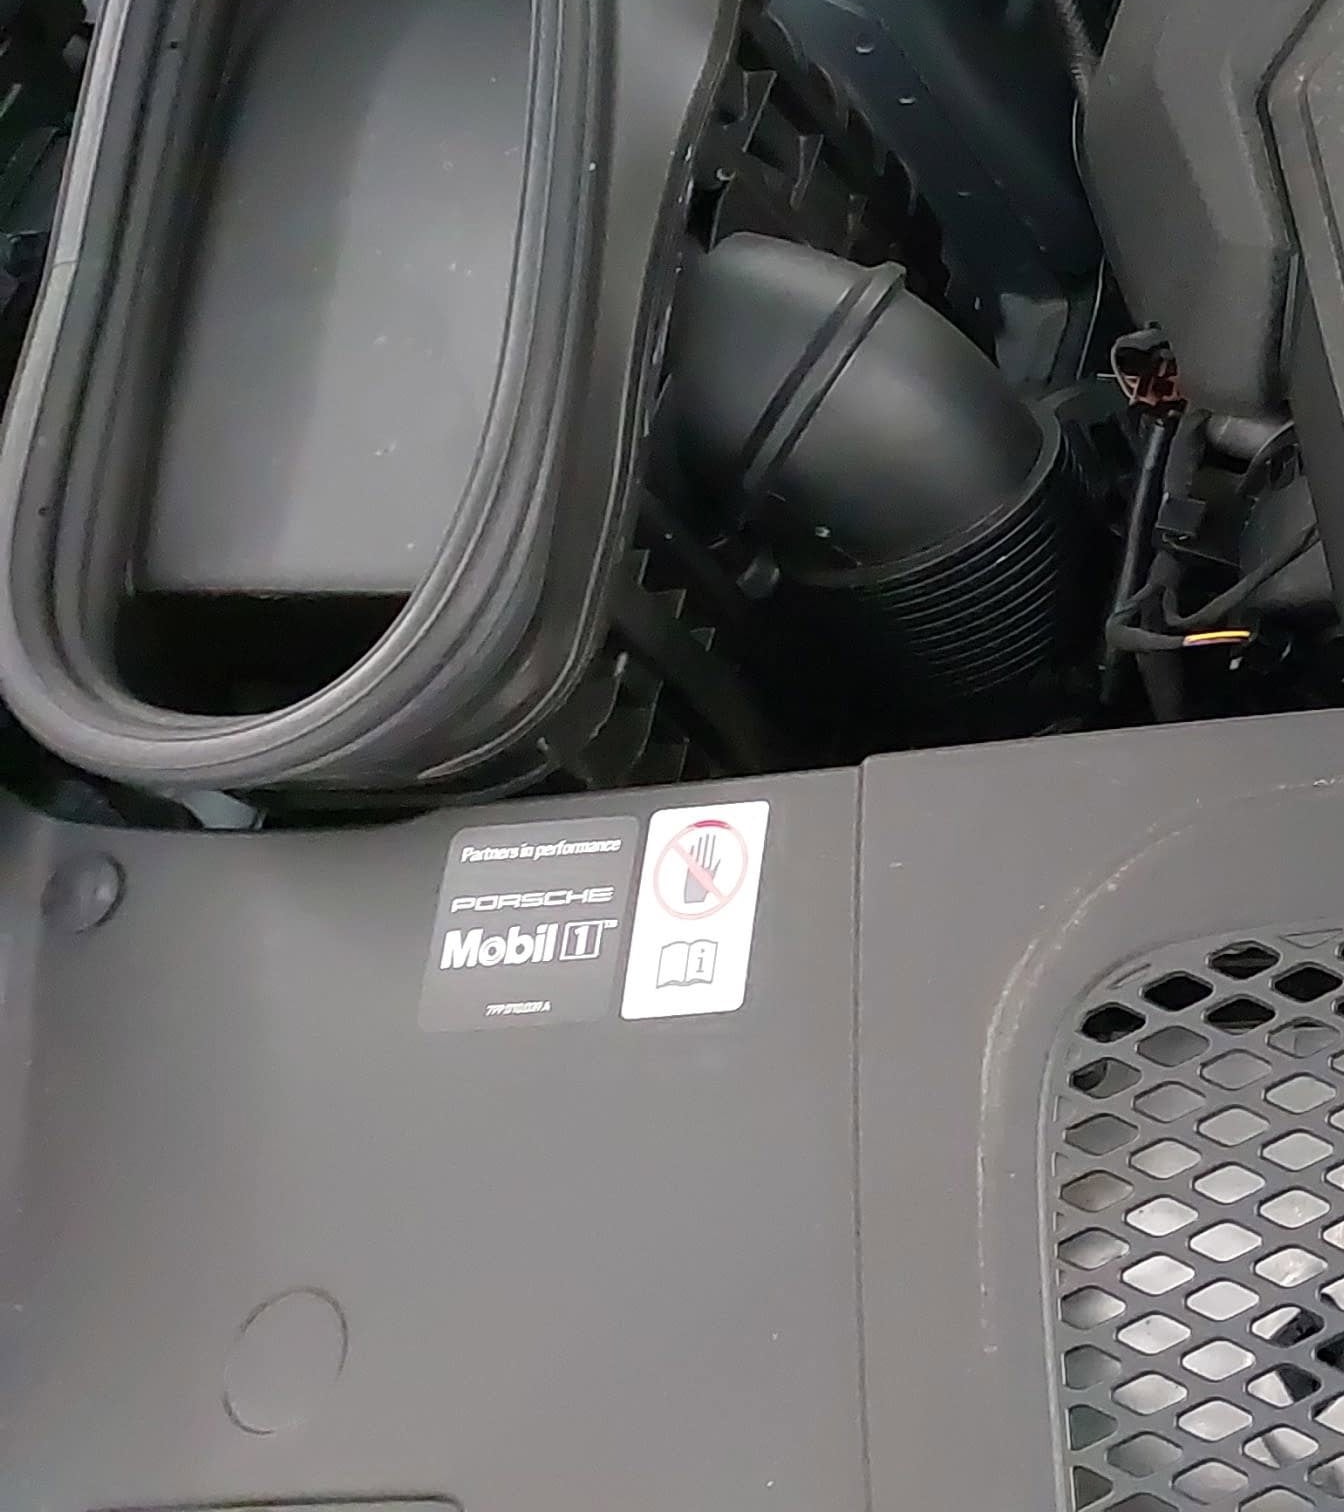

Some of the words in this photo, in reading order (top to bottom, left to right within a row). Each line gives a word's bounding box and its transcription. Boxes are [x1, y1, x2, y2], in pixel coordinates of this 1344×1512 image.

[460, 846, 519, 863] Partners
[519, 842, 535, 858] in
[533, 839, 622, 861] performance
[450, 886, 616, 913] PORSCHE
[439, 922, 559, 970] Mobil
